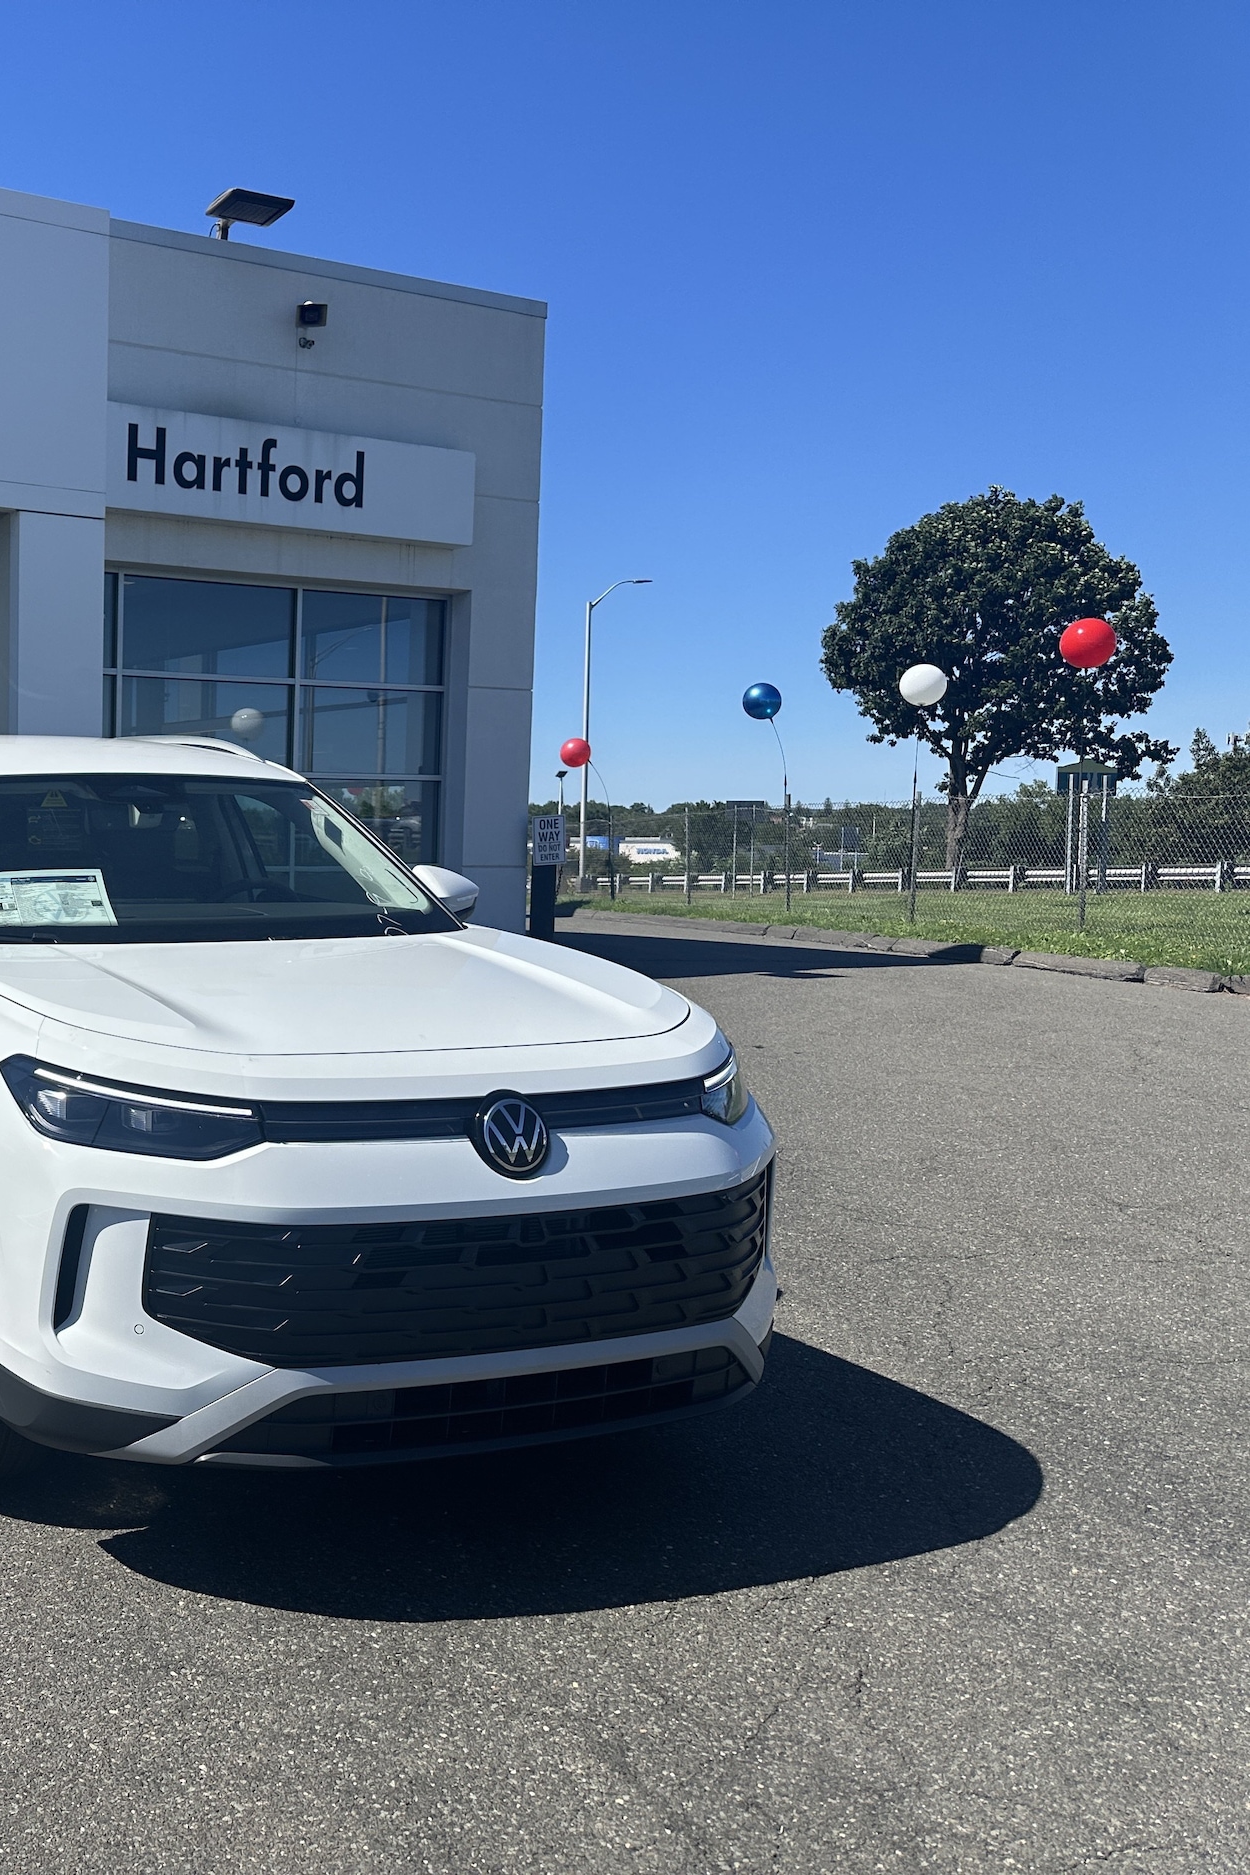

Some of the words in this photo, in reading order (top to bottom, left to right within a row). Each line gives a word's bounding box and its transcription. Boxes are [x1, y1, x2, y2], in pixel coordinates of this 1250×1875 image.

[126, 422, 365, 509] Hartford
[539, 818, 559, 830] ONE
[538, 831, 560, 842] WAY
[538, 844, 548, 853] DO
[549, 843, 560, 852] NOT
[540, 852, 560, 861] ENTER
